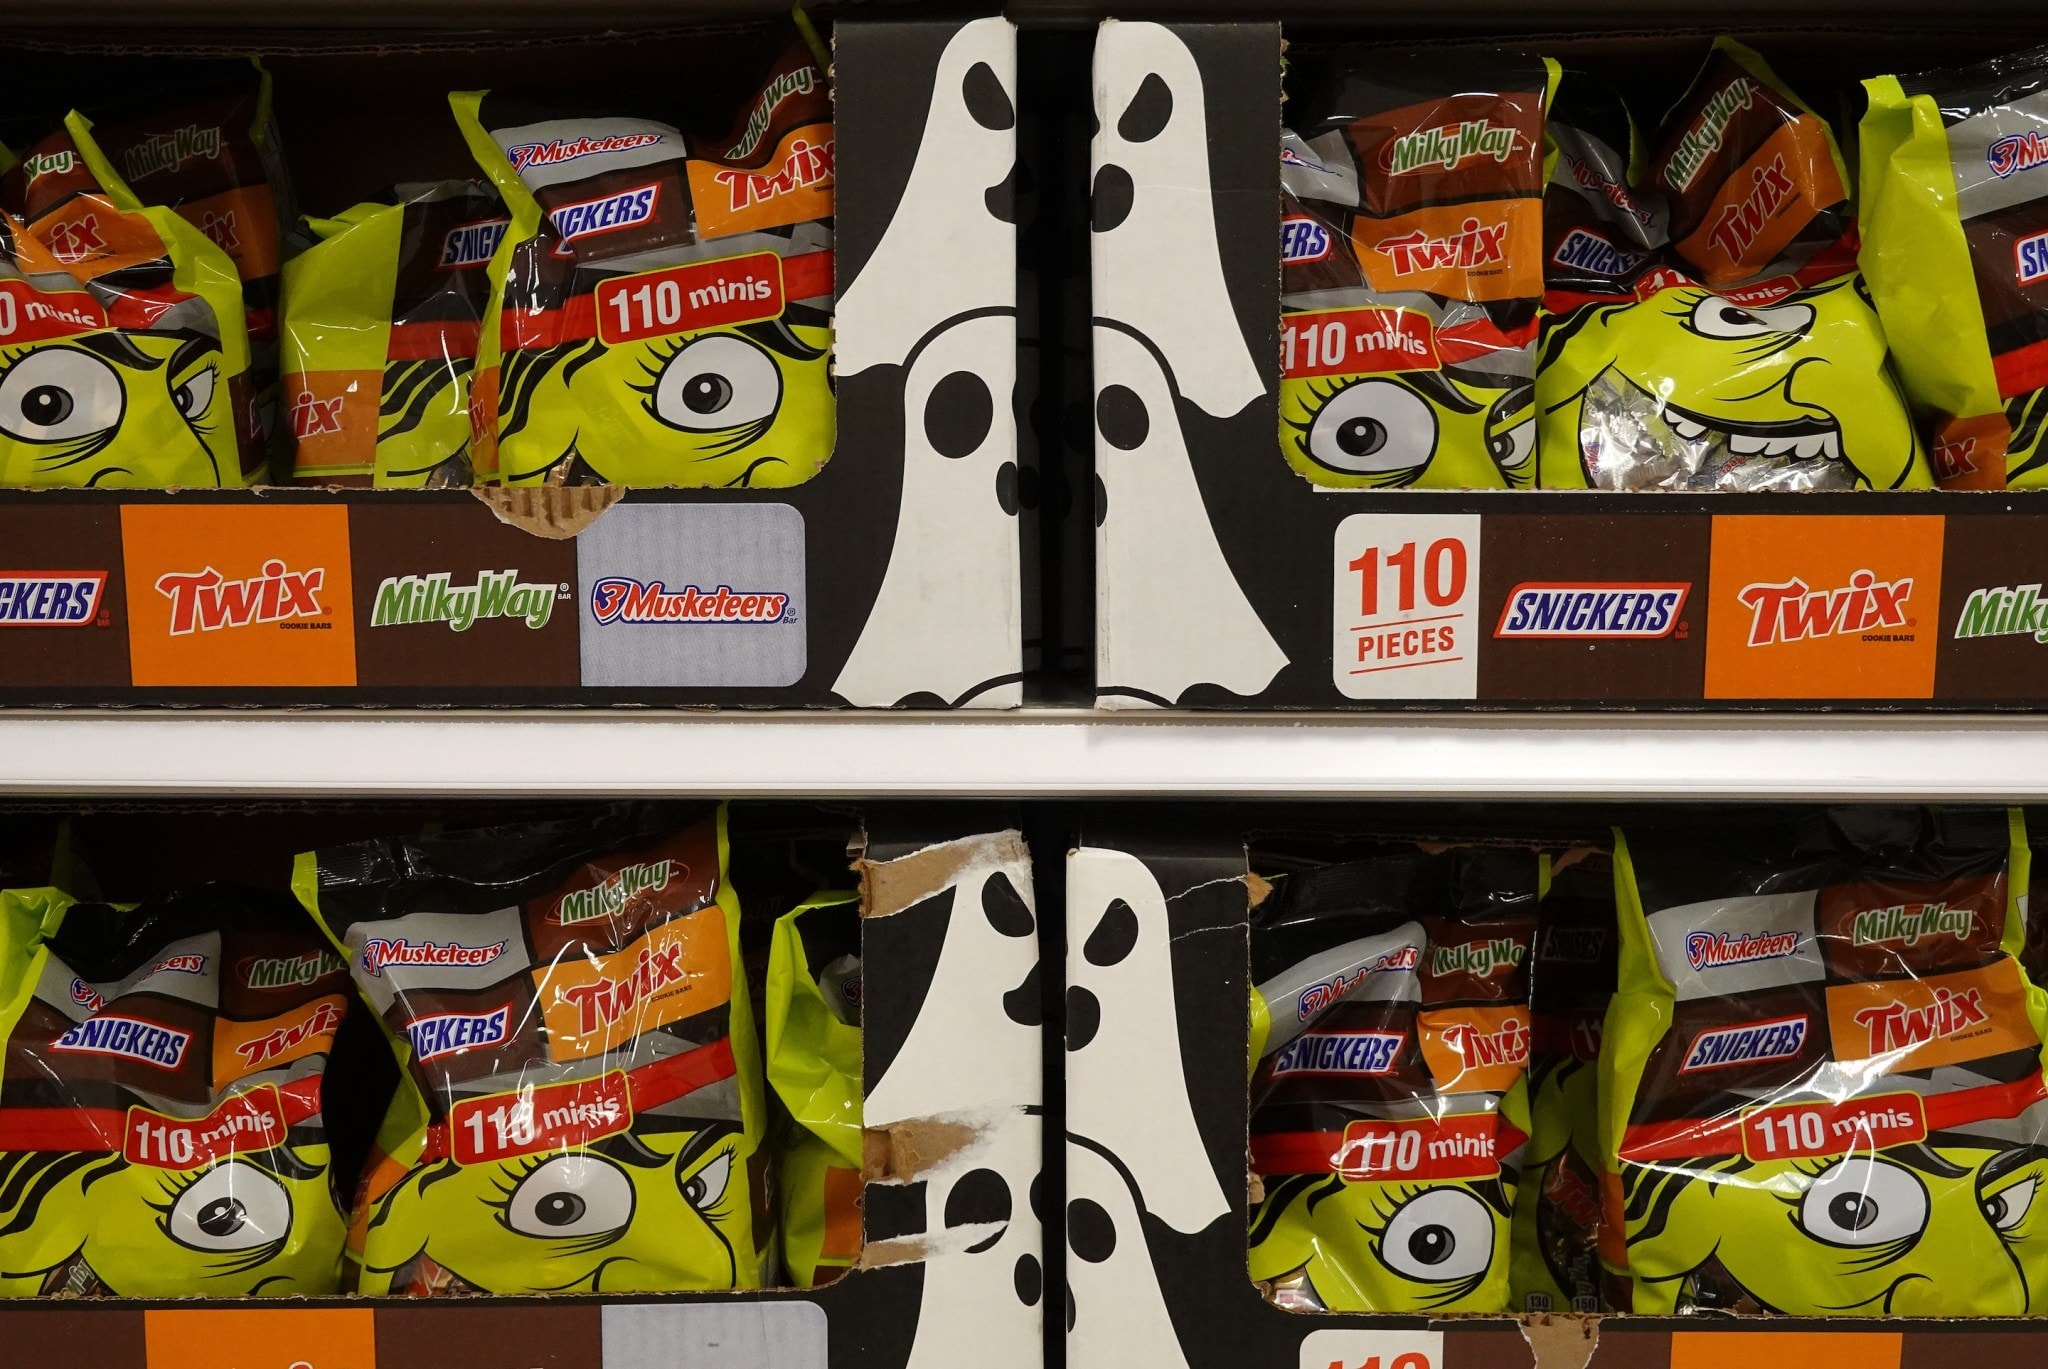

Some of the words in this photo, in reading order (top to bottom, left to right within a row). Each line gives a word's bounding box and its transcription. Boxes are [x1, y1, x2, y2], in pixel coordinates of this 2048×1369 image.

[533, 133, 662, 167] Musketeers
[1708, 153, 1794, 266] Twix
[1376, 216, 1507, 276] Twix
[608, 280, 681, 333] 110
[689, 275, 772, 310] minis
[155, 559, 325, 636] Twix
[1349, 538, 1468, 616] 110
[623, 581, 788, 622] Musketeers
[783, 616, 798, 625] Bar
[1506, 592, 1678, 632] SNICKERS
[1737, 569, 1914, 647] Twix
[280, 622, 308, 630] COOKIE
[1358, 626, 1455, 662] PIECES
[377, 940, 502, 966] Musketeers
[1702, 931, 1797, 967] Musketeers
[564, 941, 687, 1037] Twix
[61, 1020, 185, 1066] SNICKERS
[1690, 1022, 1804, 1067] SNICKERS
[1854, 987, 1988, 1057] Twix
[1277, 1037, 1400, 1072] SNICKERS
[136, 1121, 192, 1163] 110
[200, 1109, 275, 1145] minis
[464, 1100, 535, 1154] 110
[543, 1096, 620, 1130] minis
[1754, 1112, 1824, 1152] 110
[1832, 1107, 1914, 1137] minis
[1353, 1130, 1421, 1172] 110
